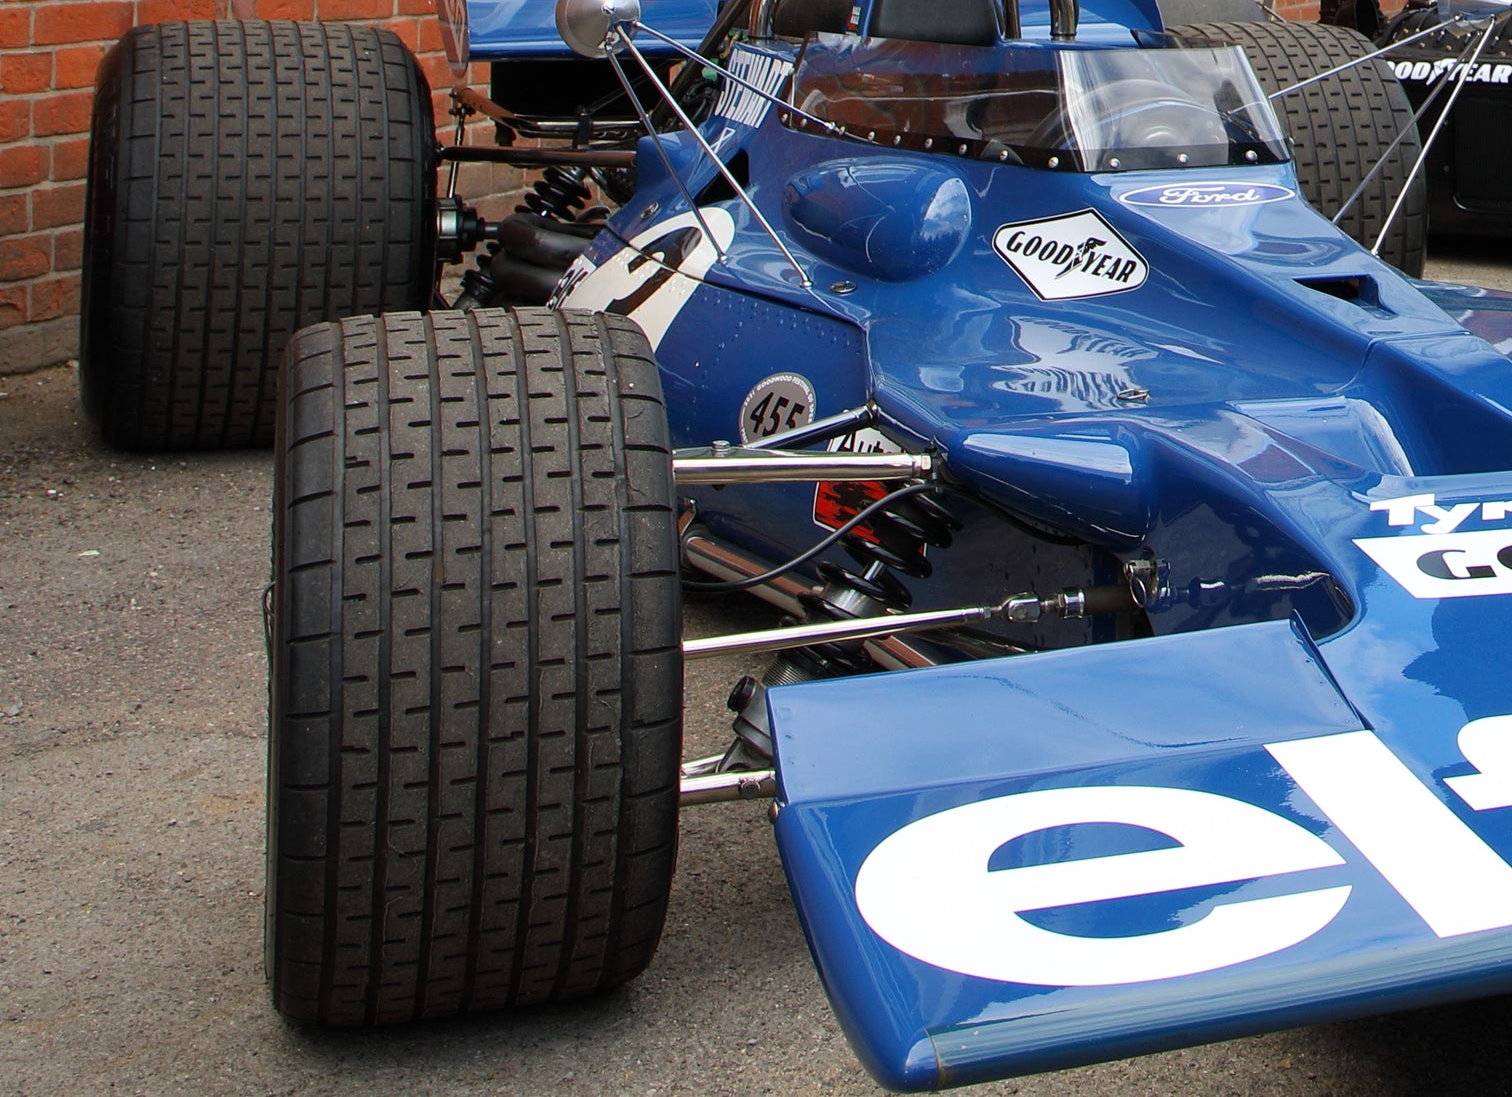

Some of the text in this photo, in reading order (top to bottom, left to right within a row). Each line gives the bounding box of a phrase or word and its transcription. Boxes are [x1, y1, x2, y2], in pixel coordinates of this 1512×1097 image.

[715, 49, 795, 129] STEWART
[1159, 186, 1261, 203] Ford
[1006, 230, 1138, 284] GOODYEAR
[750, 391, 806, 436] 455
